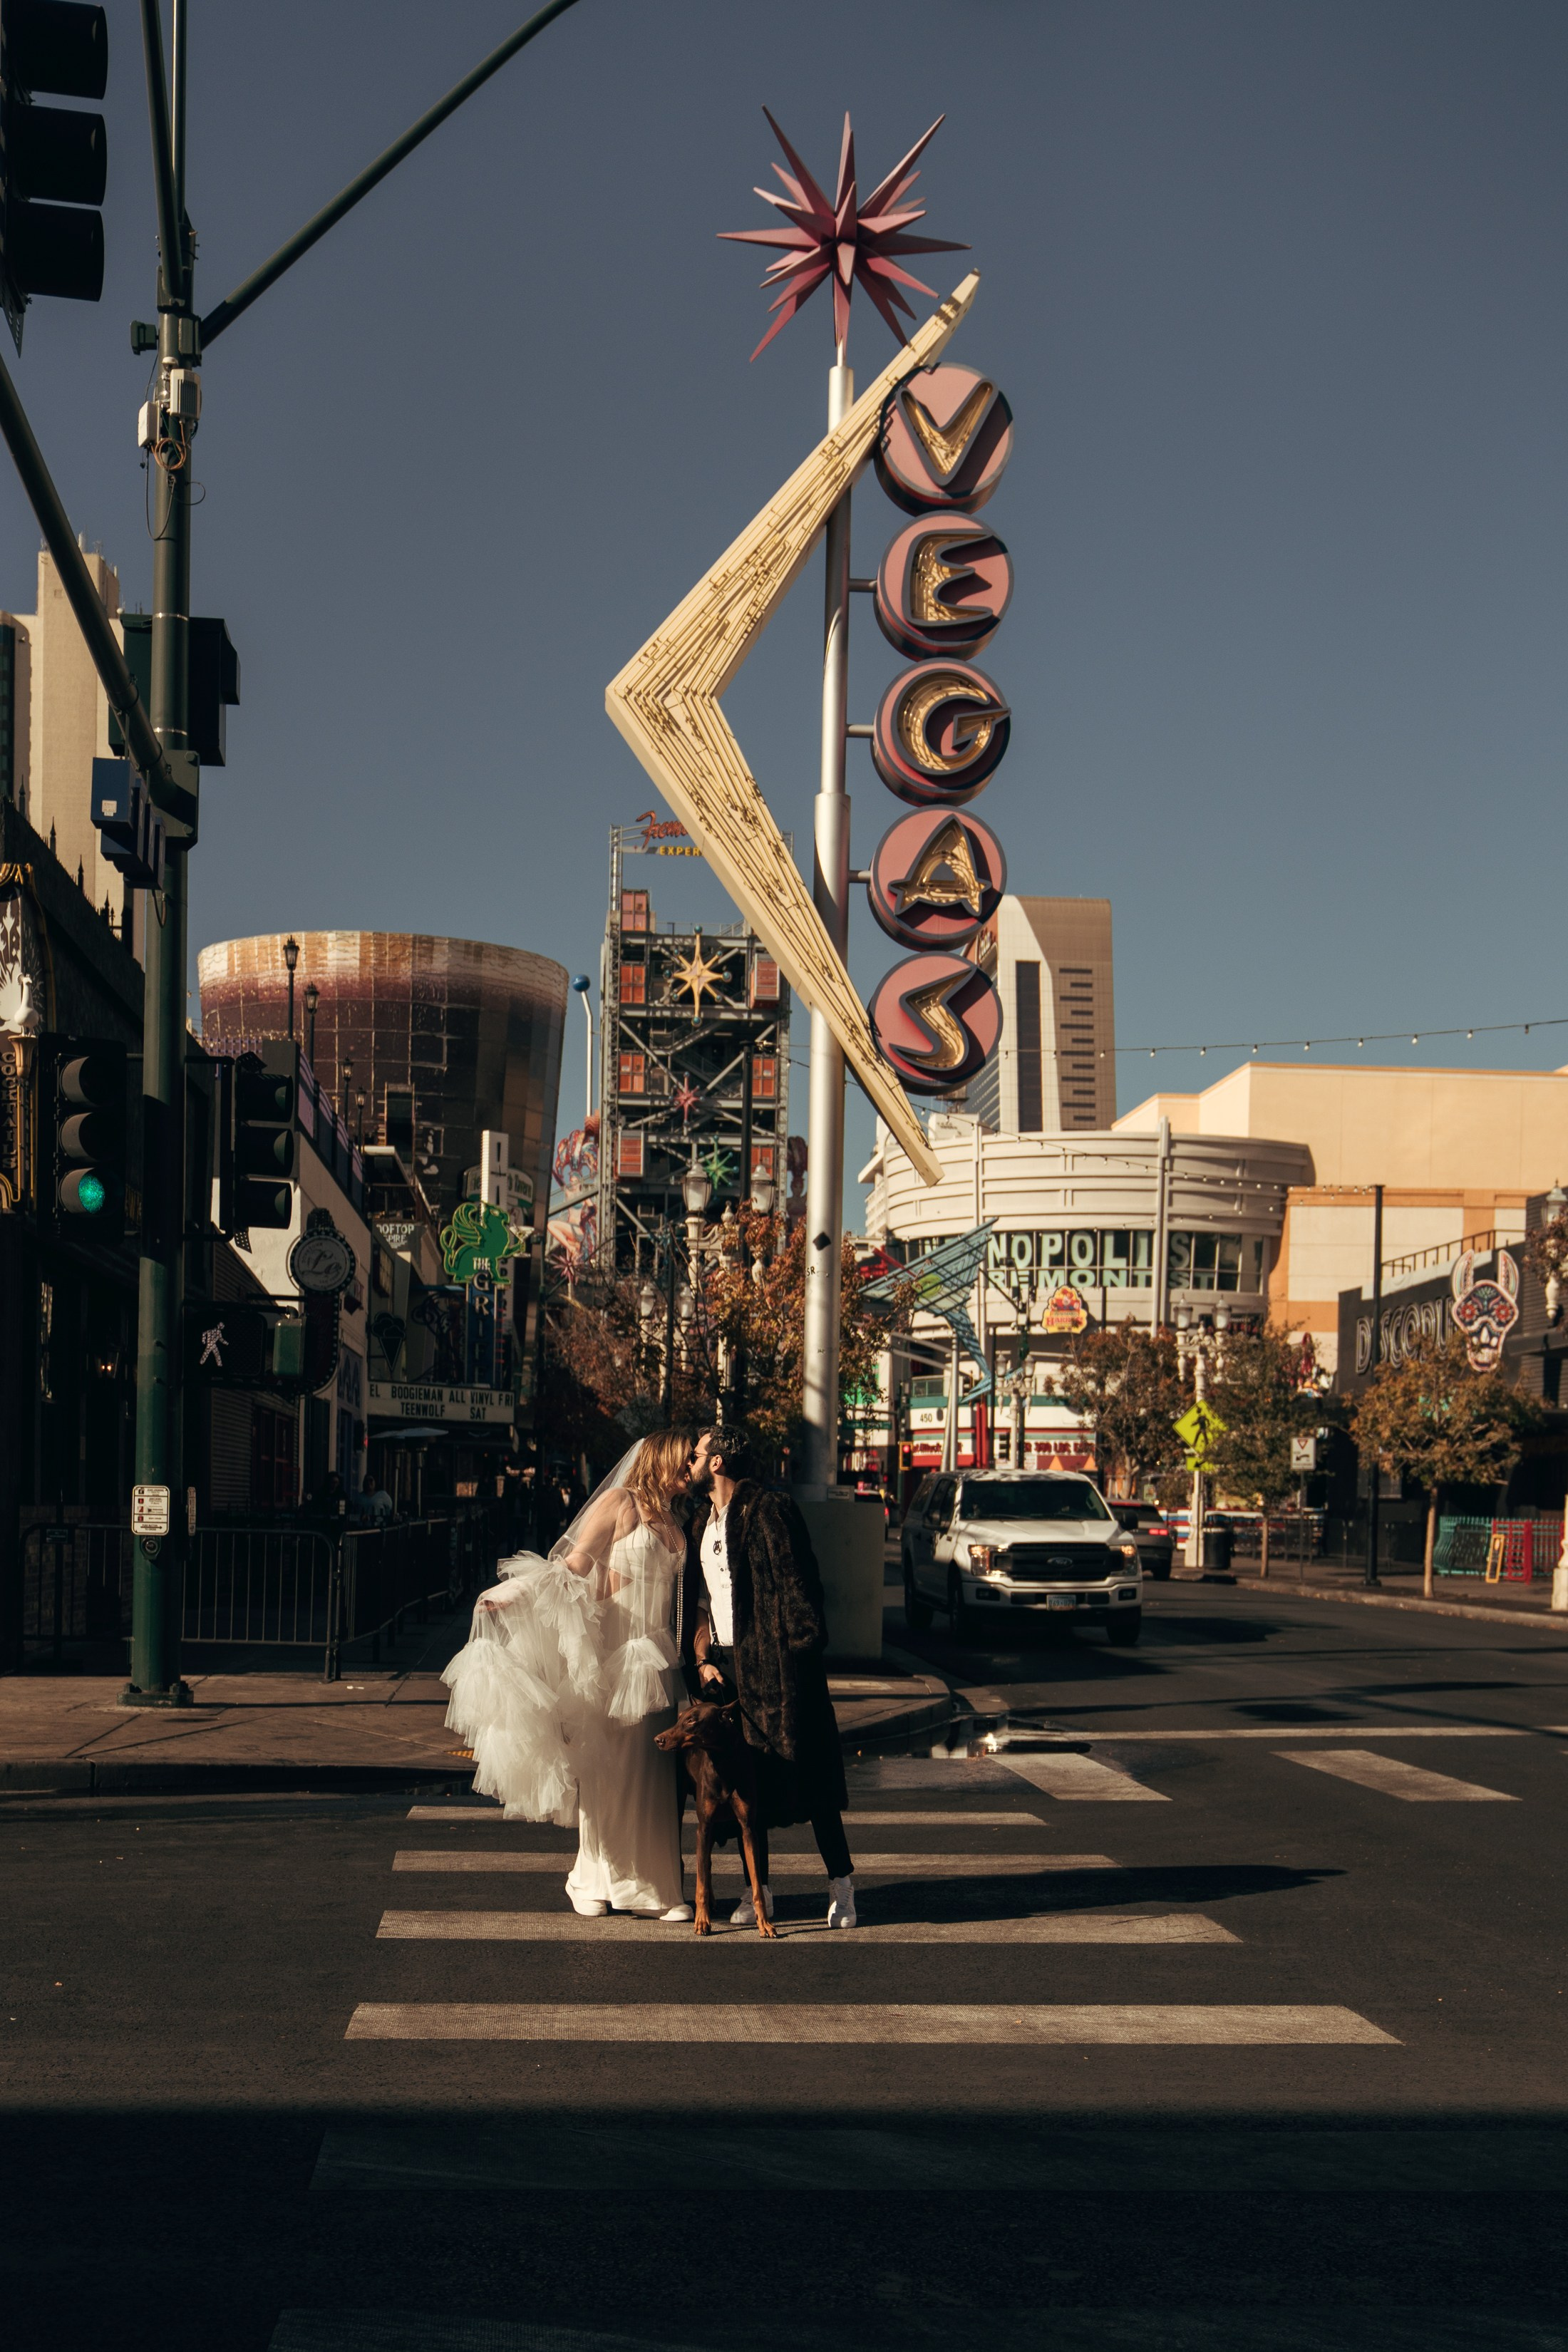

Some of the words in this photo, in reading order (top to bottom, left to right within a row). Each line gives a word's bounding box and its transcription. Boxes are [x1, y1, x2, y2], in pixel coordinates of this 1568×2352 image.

[889, 378, 1012, 1071] VEGAS
[1, 1052, 17, 1169] COCKTAILS
[473, 1257, 492, 1271] THE
[988, 1270, 1152, 1289] REMONT
[1169, 1271, 1214, 1289] ST
[369, 1384, 380, 1398] EL
[391, 1386, 443, 1402] BOOGIEMAN
[449, 1391, 465, 1403] ALL
[470, 1393, 494, 1405] VINYL
[498, 1393, 513, 1406] FRI
[401, 1402, 445, 1418] TEENWOLF
[470, 1407, 486, 1420] SAT
[919, 1413, 933, 1423] 450
